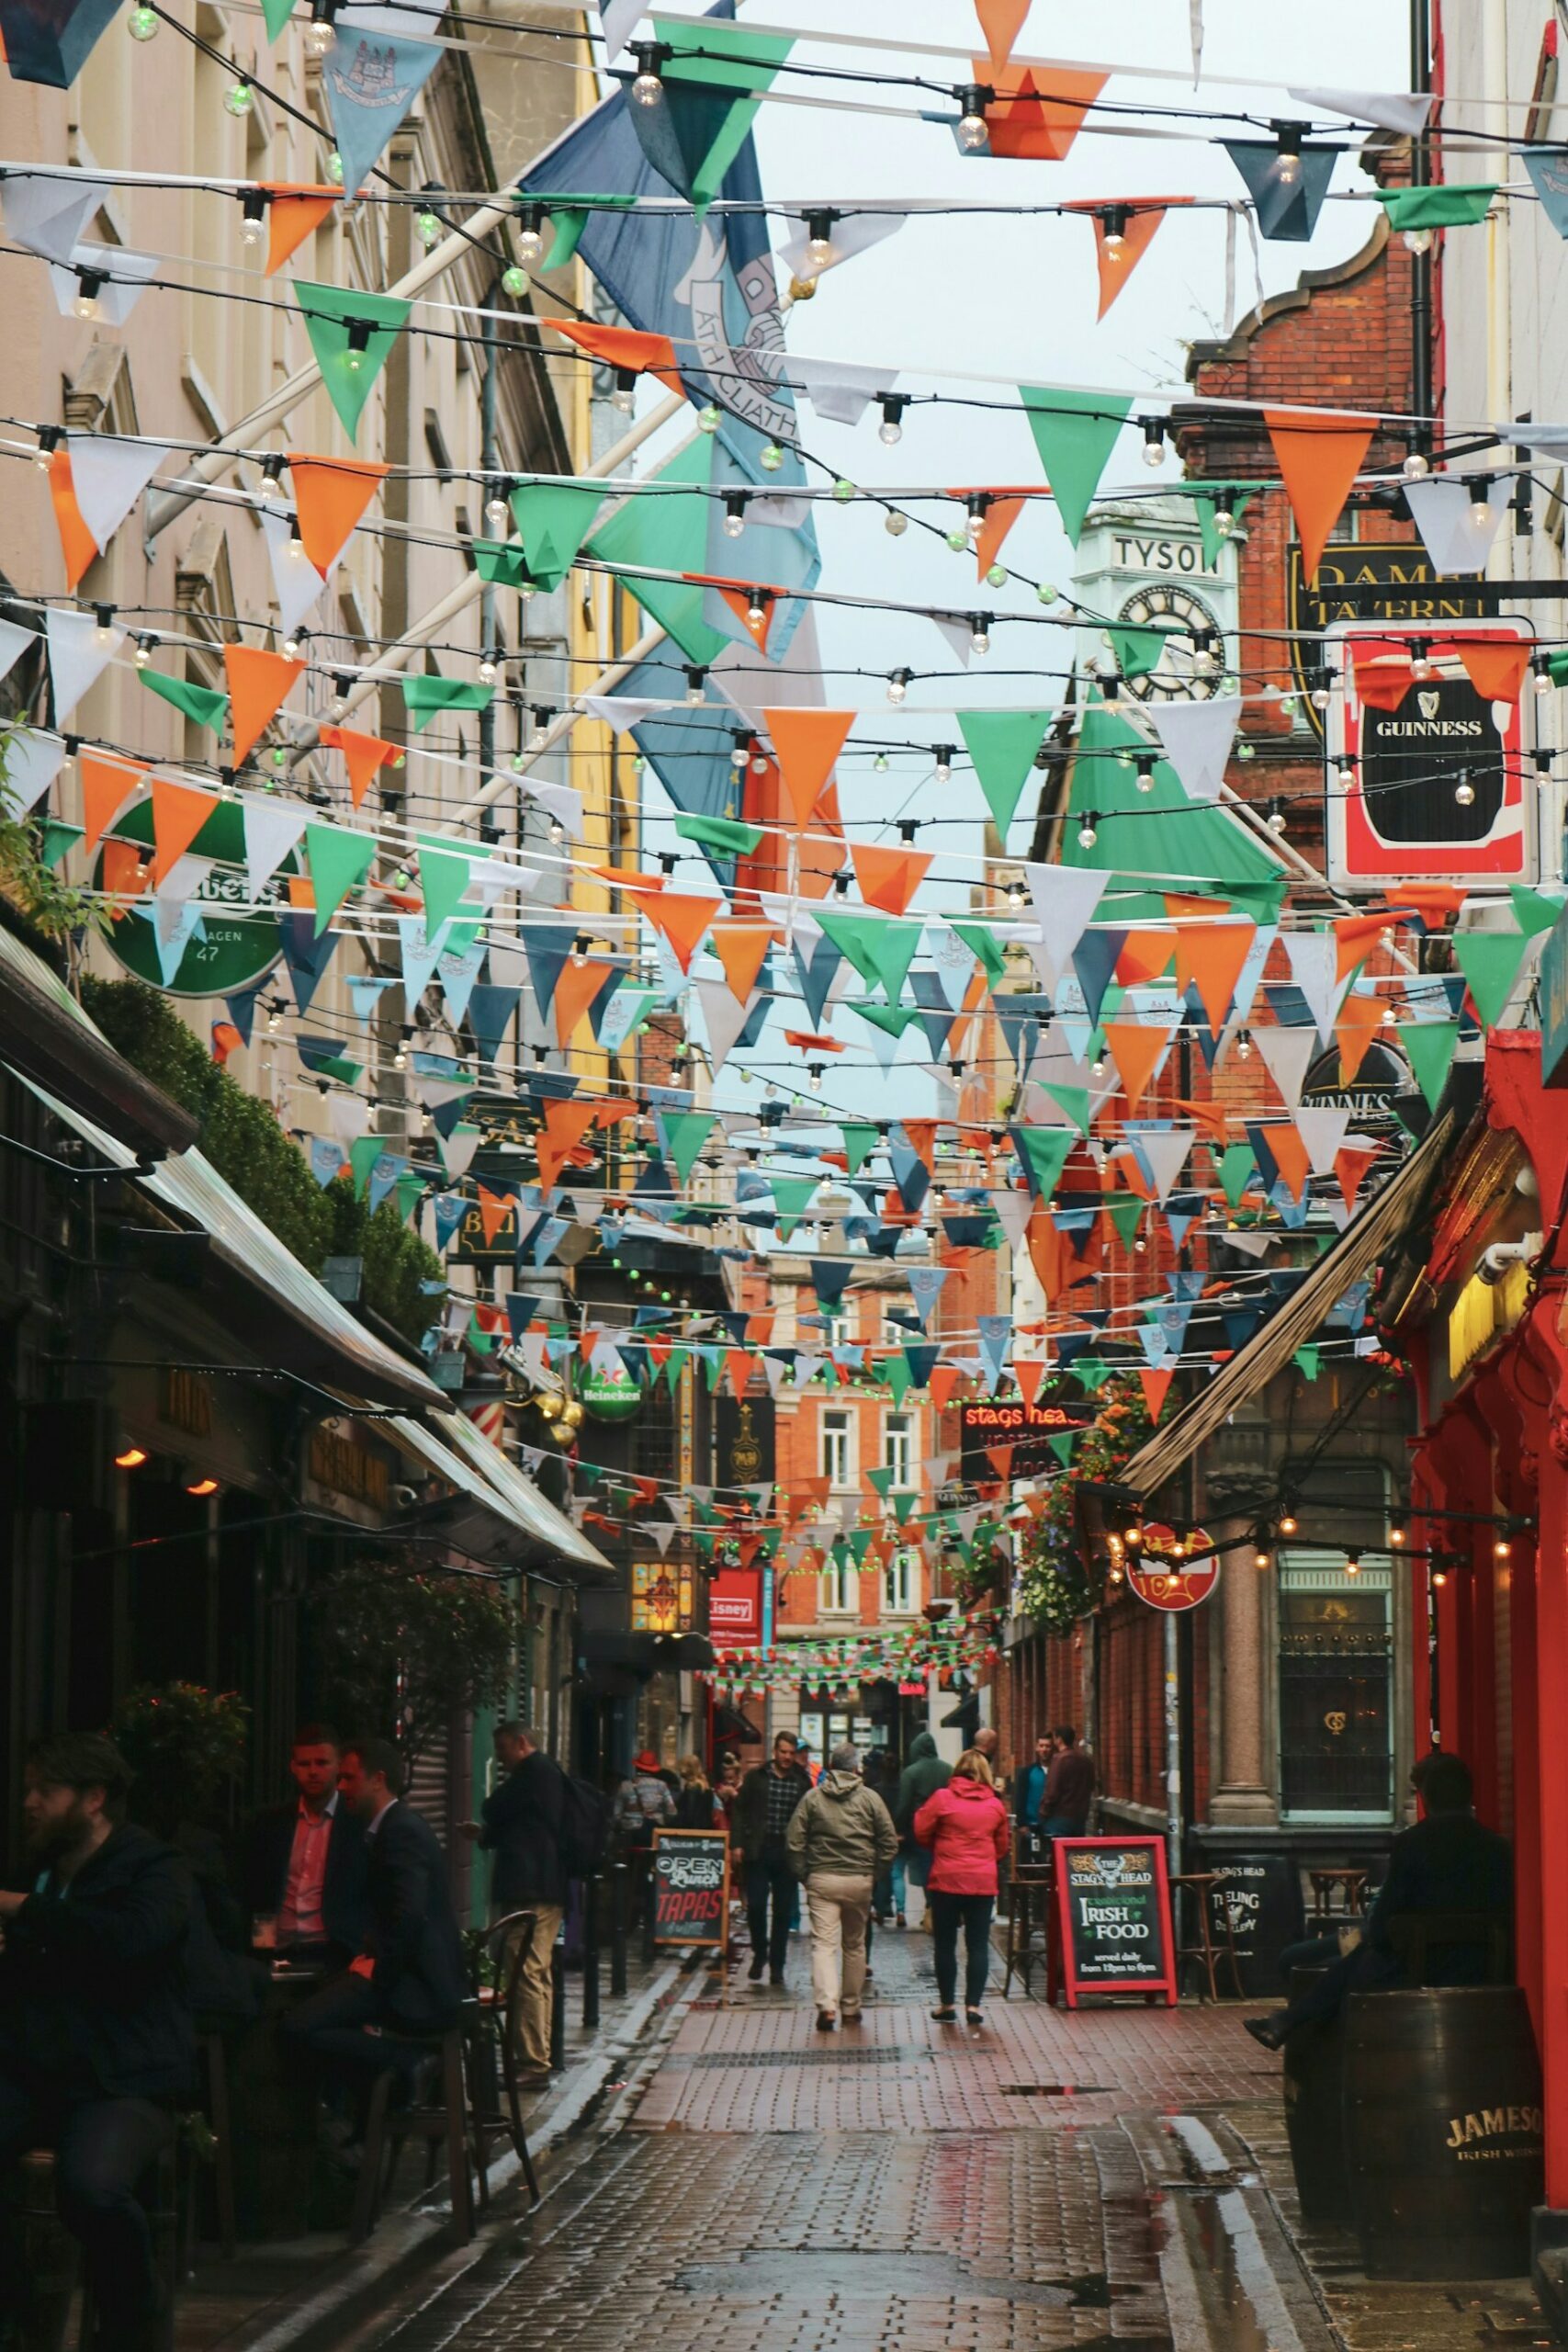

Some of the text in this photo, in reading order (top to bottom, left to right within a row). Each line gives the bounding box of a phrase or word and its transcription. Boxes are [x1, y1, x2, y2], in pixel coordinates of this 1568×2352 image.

[718, 373, 798, 435] CLIATH
[1309, 599, 1464, 625] TAERN
[1376, 720, 1483, 737] GUINNESS
[1300, 1093, 1392, 1121] GUINNES
[583, 1389, 641, 1402] Heineken
[965, 1405, 1083, 1429] stags hea
[656, 1856, 725, 1875] OPEN
[1100, 1860, 1118, 1869] THE
[1243, 1867, 1266, 1876] HEAD
[1121, 1872, 1153, 1883] HEAD
[656, 1890, 724, 1923] TAPAS
[1078, 1897, 1129, 1927] IRISH
[1096, 1923, 1149, 1939] FOOD
[1094, 1953, 1121, 1962] served
[1080, 1964, 1101, 1973] from
[1447, 2107, 1544, 2147] JAMESO
[1457, 2150, 1501, 2161] IRISH
